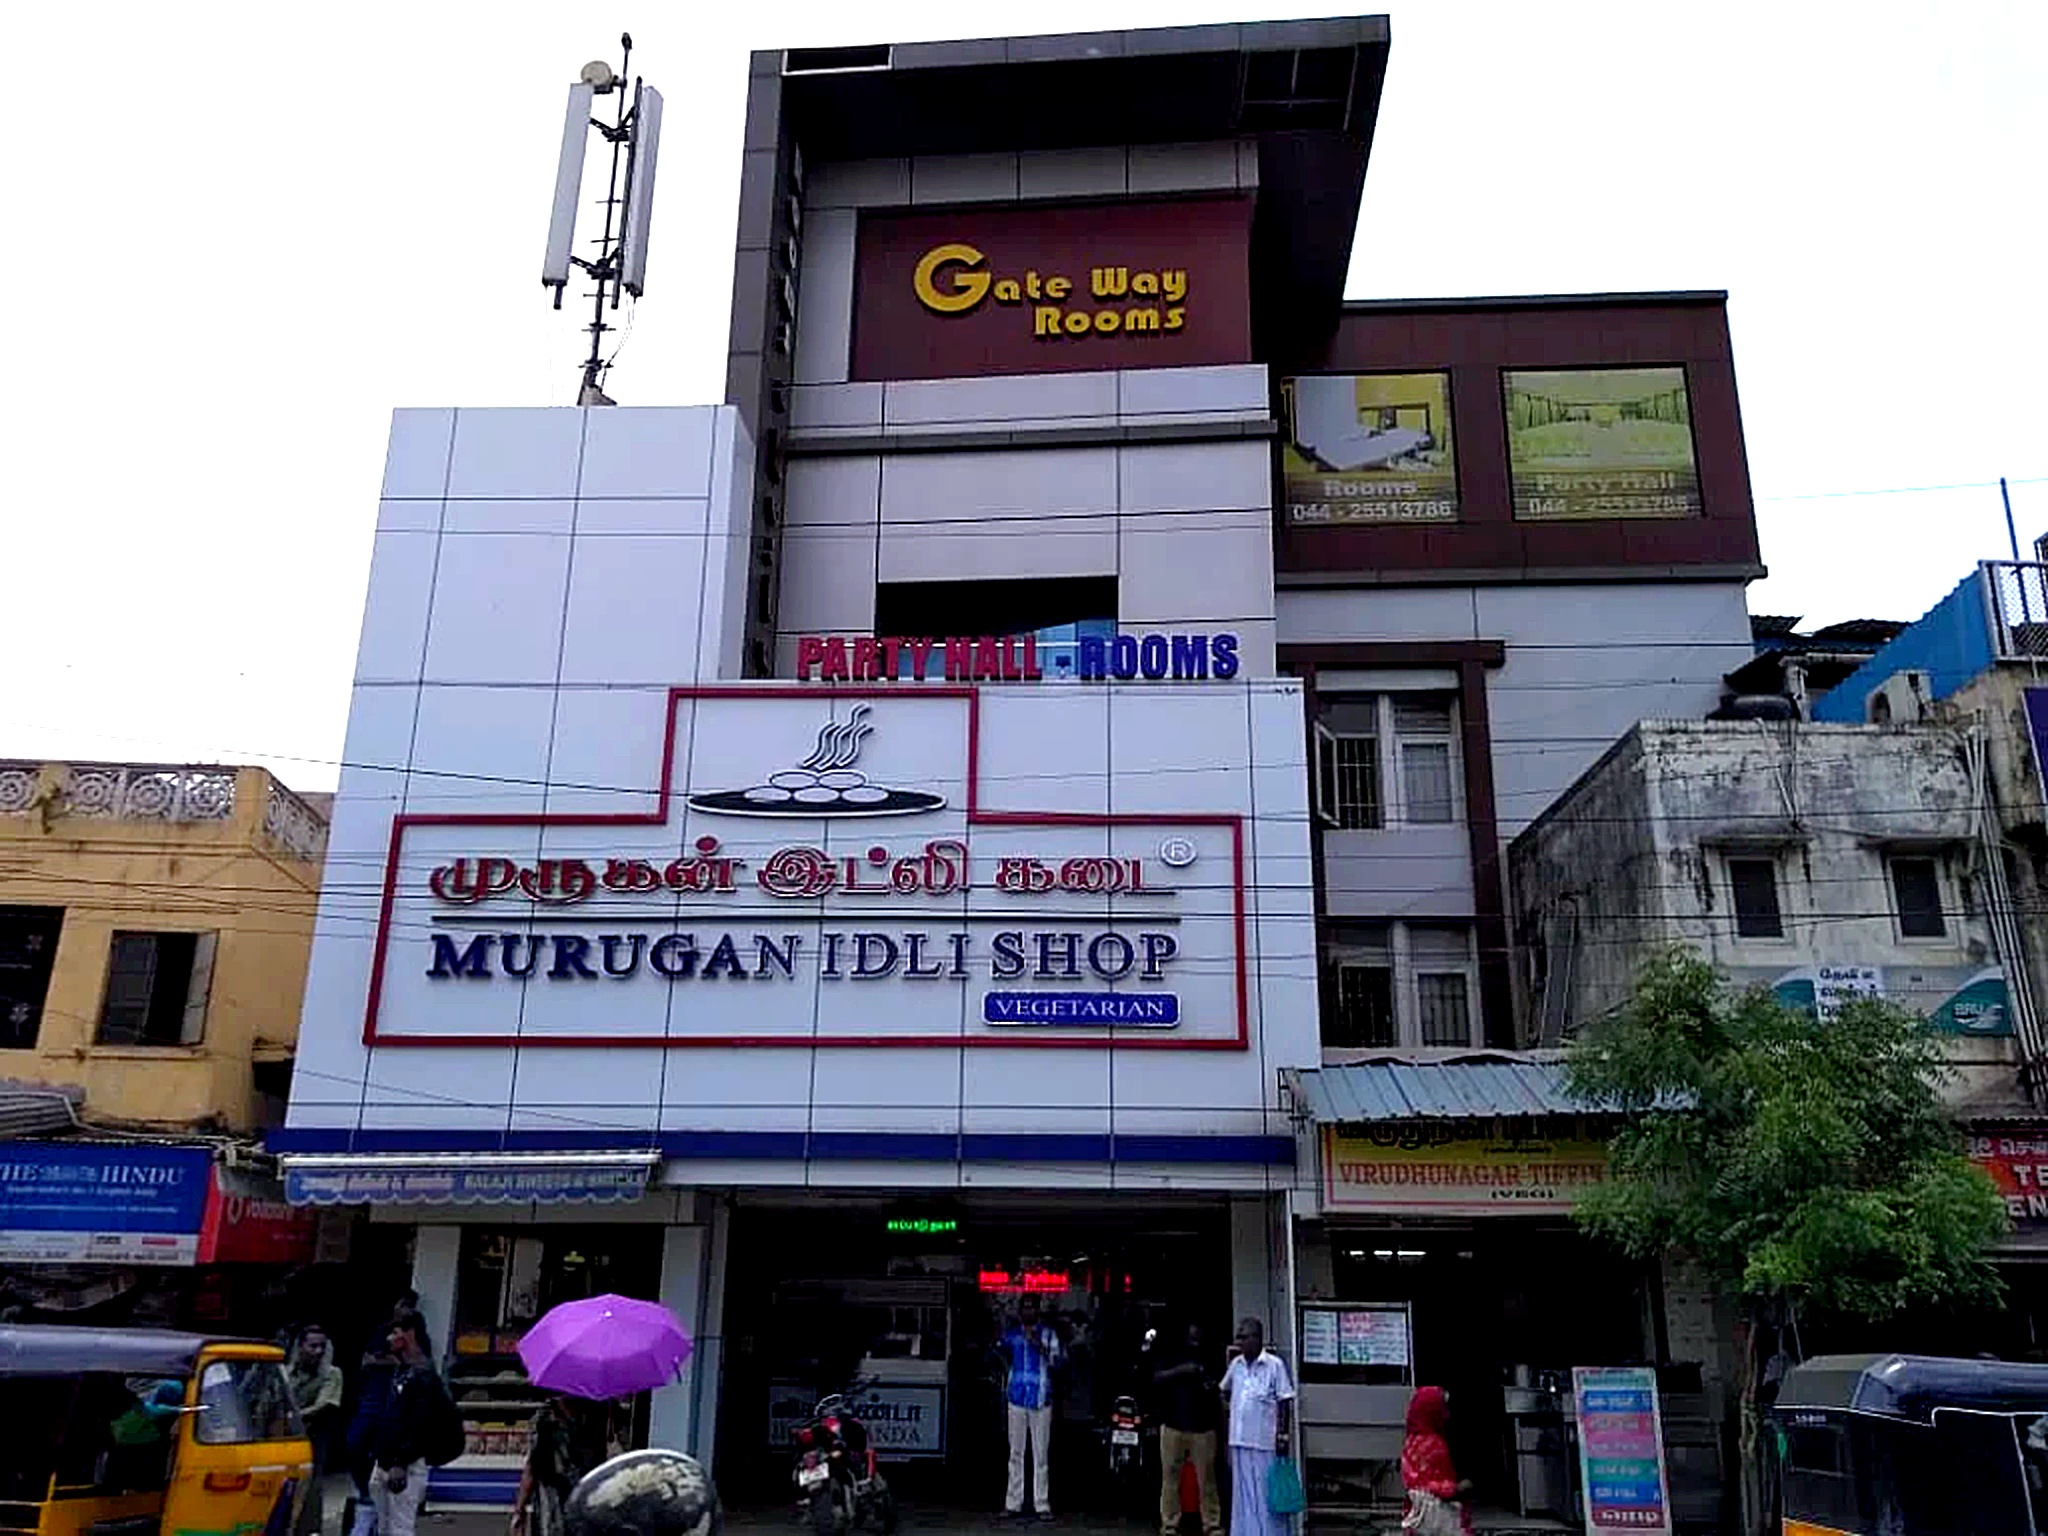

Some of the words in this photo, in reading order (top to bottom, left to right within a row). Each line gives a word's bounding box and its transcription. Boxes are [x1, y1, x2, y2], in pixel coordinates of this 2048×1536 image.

[914, 243, 1073, 313] Gate
[1091, 267, 1188, 301] Way
[1033, 306, 1187, 337] Rooms
[1324, 480, 1418, 497] Rooms
[1293, 505, 1330, 521] 044
[799, 635, 935, 681] PARTY
[945, 635, 1043, 681] HALL
[1080, 634, 1238, 681] ROOMS
[430, 835, 747, 905] முருகன்
[757, 840, 970, 900] இட்லி
[996, 856, 1176, 897] கடை
[426, 933, 802, 981] MURUGAN
[821, 932, 971, 981] IDLI
[991, 931, 1180, 981] SHOP
[997, 1001, 1166, 1018] VEGETARIAN
[100, 1164, 186, 1185] HINDU
